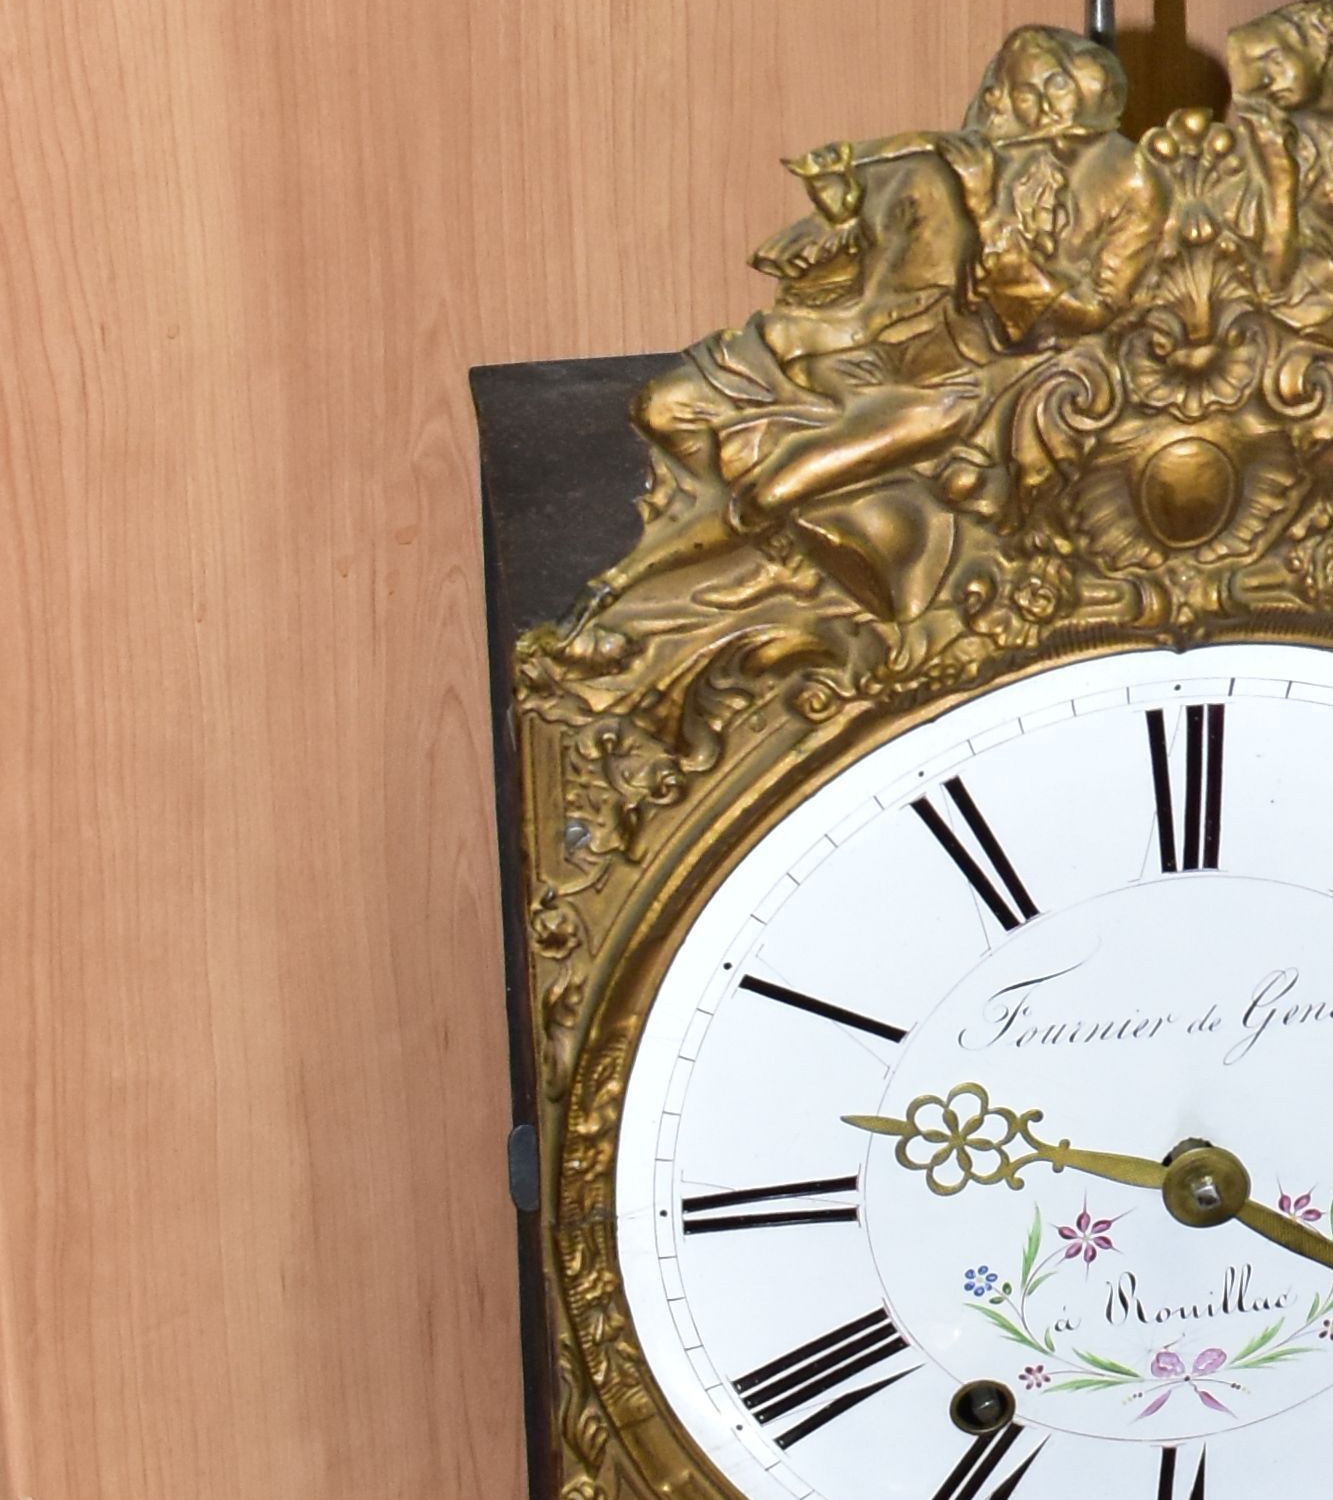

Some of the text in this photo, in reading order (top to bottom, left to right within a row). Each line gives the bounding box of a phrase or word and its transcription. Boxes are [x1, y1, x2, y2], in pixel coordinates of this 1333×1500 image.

[959, 956, 1174, 1050] Fournier
[1188, 1004, 1222, 1034] de
[1054, 1263, 1296, 1332] à Rouillac
